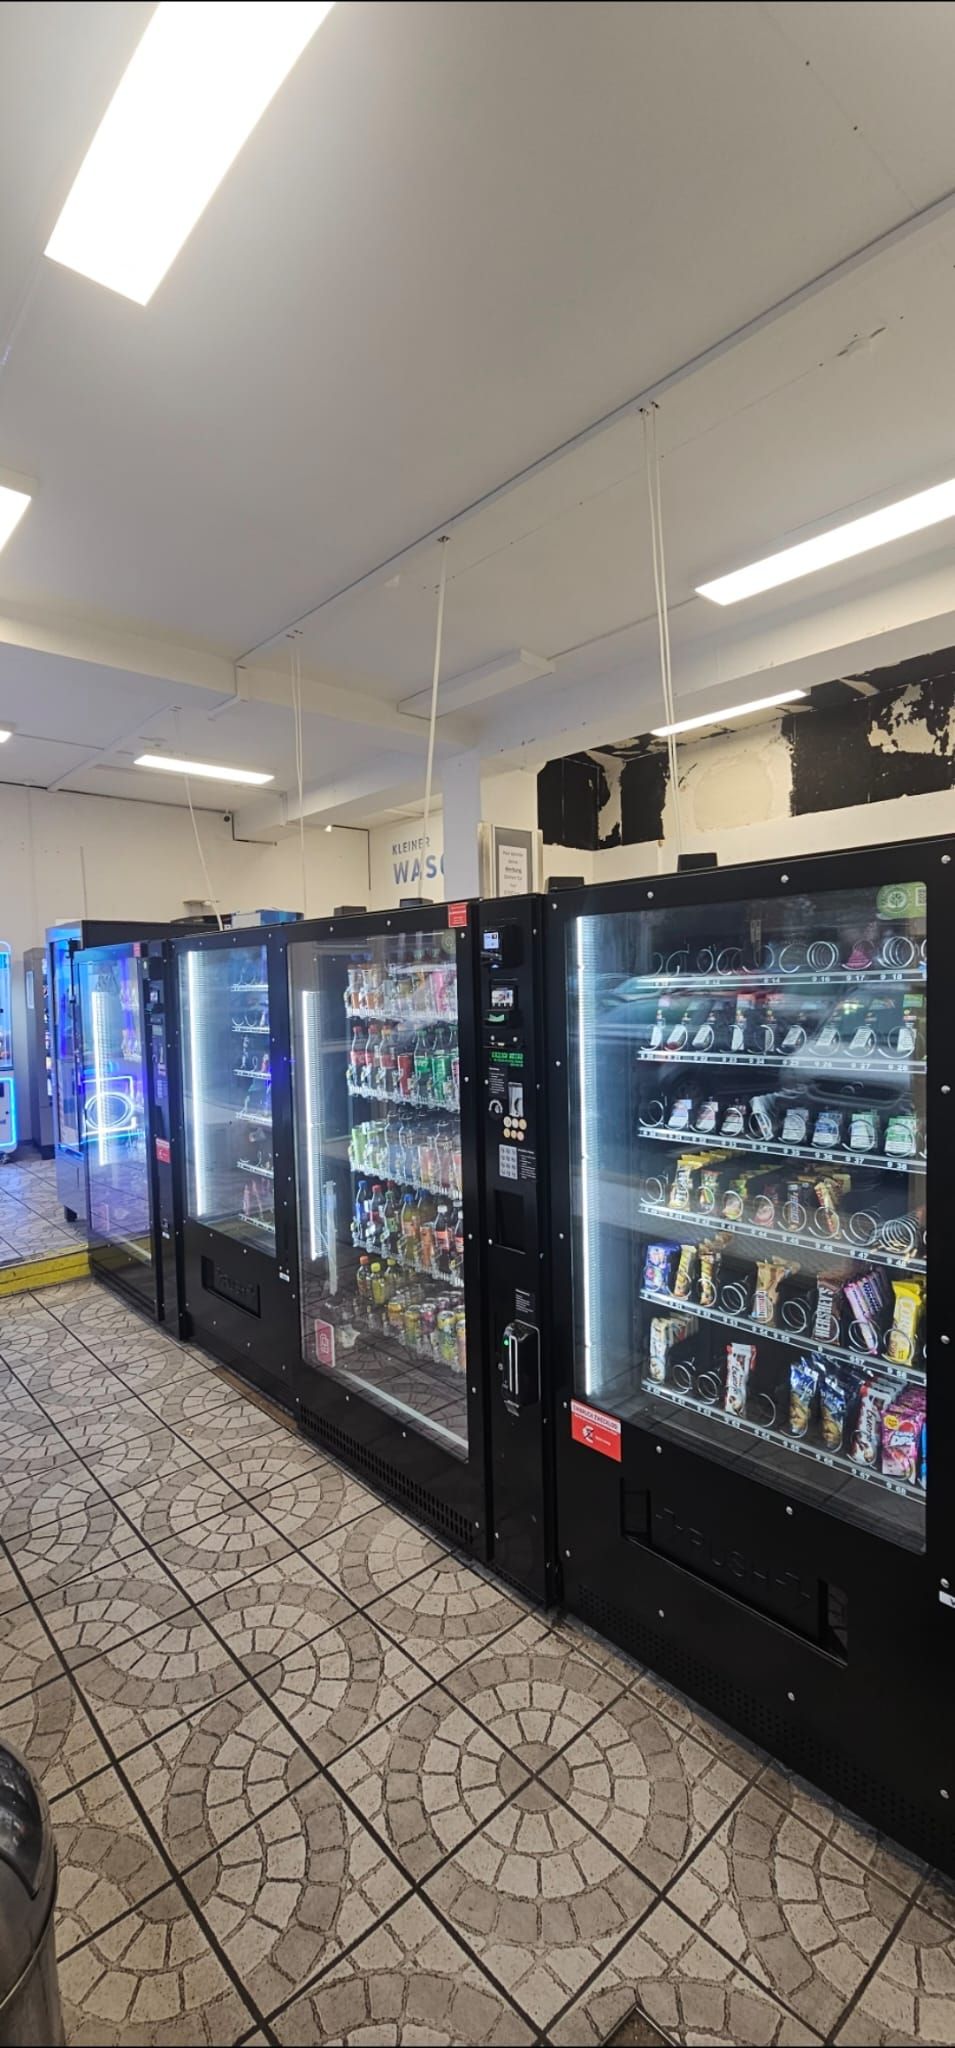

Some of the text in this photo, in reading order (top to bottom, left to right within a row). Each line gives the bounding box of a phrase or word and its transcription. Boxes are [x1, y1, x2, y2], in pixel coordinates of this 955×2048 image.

[392, 837, 430, 855] KLEINER
[814, 1287, 834, 1338] HERSHEY'S
[865, 1408, 876, 1441] bueno
